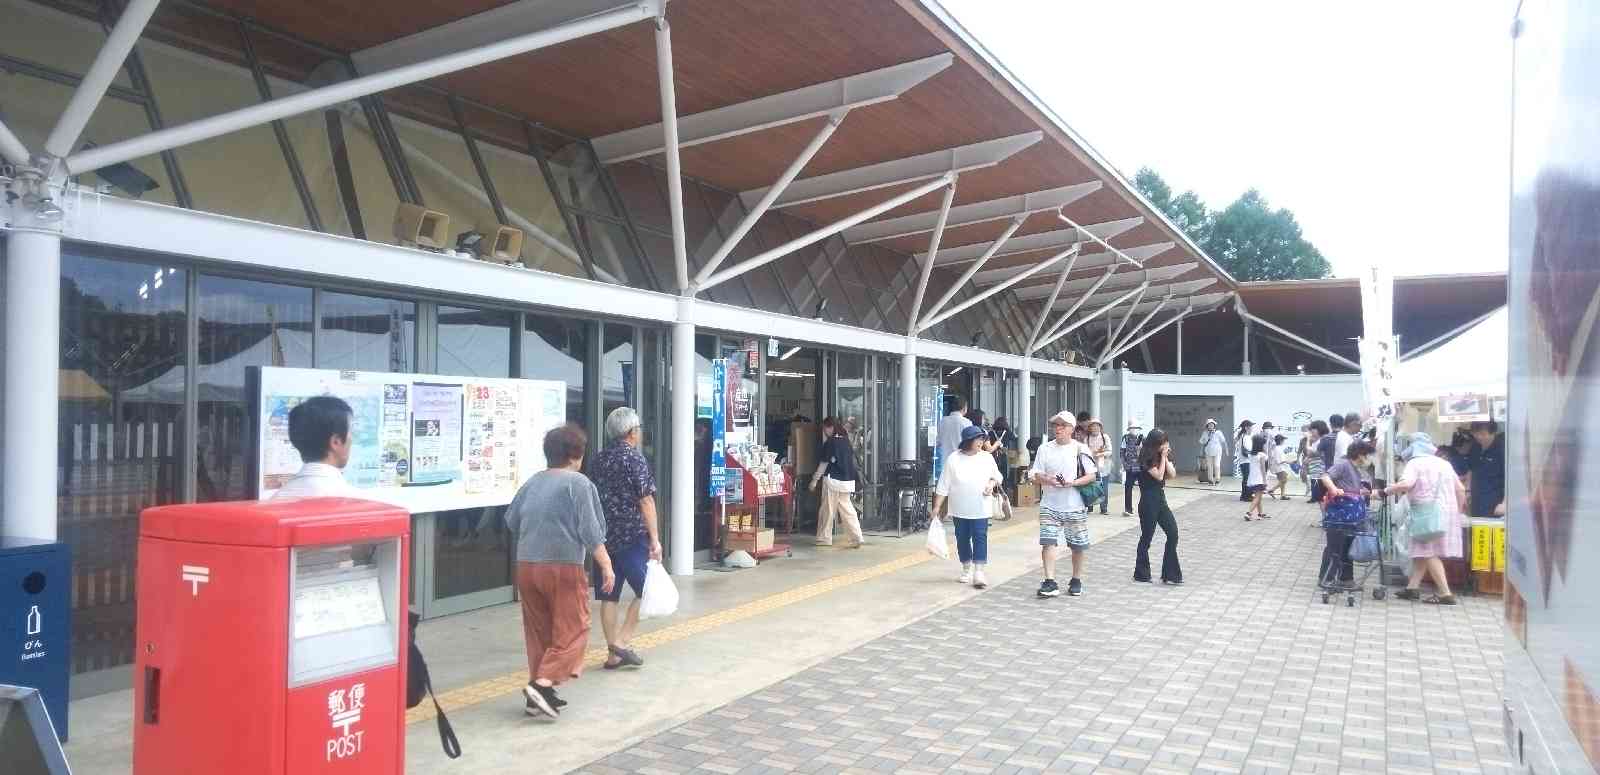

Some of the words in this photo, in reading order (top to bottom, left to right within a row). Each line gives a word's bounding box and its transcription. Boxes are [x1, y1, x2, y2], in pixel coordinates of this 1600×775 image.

[24, 639, 43, 650] びん
[327, 683, 366, 717] 郵便
[327, 730, 365, 763] POST
